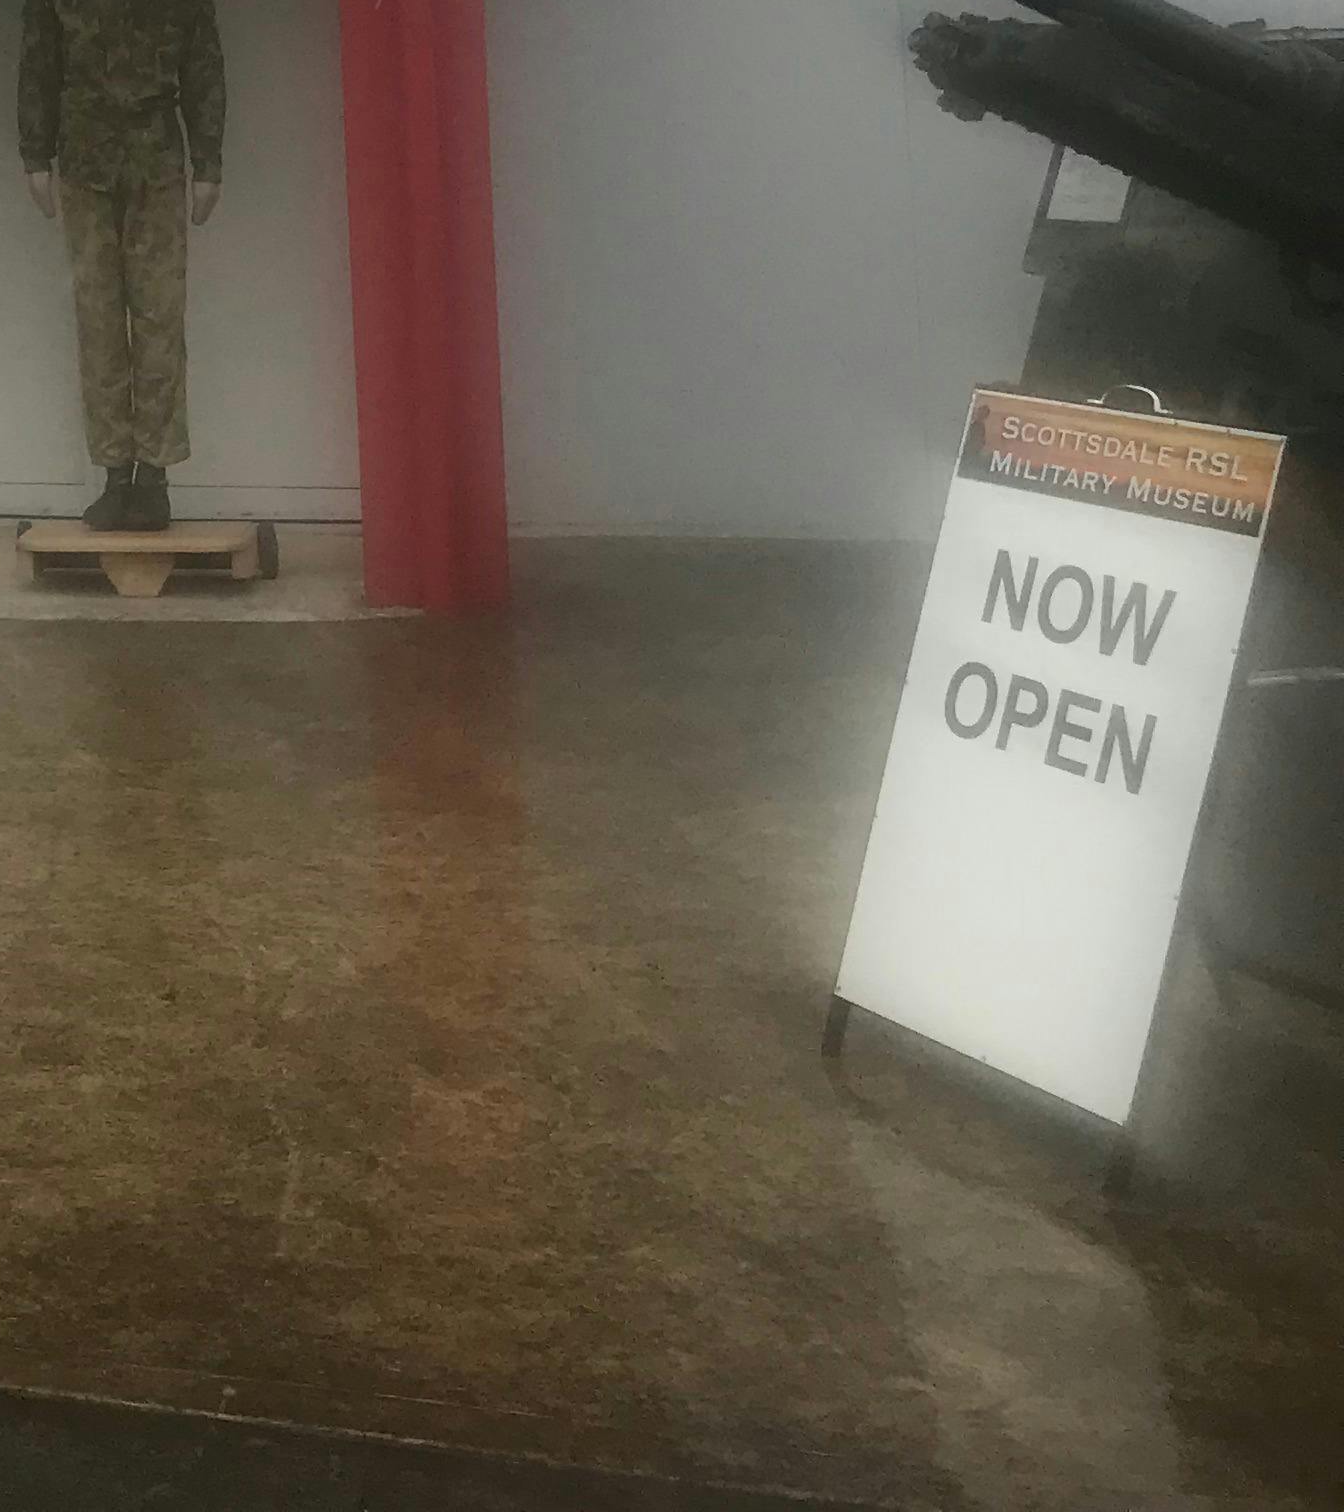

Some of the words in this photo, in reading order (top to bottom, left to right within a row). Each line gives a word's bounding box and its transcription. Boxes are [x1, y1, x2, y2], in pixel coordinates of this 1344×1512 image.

[989, 450, 1118, 496] MILITARY
[1126, 477, 1256, 523] MUSEUM
[1002, 415, 1174, 469] SCOTTSDALE
[1185, 448, 1248, 482] RSL
[981, 549, 1177, 666] NOW
[943, 660, 1158, 795] OPEN
